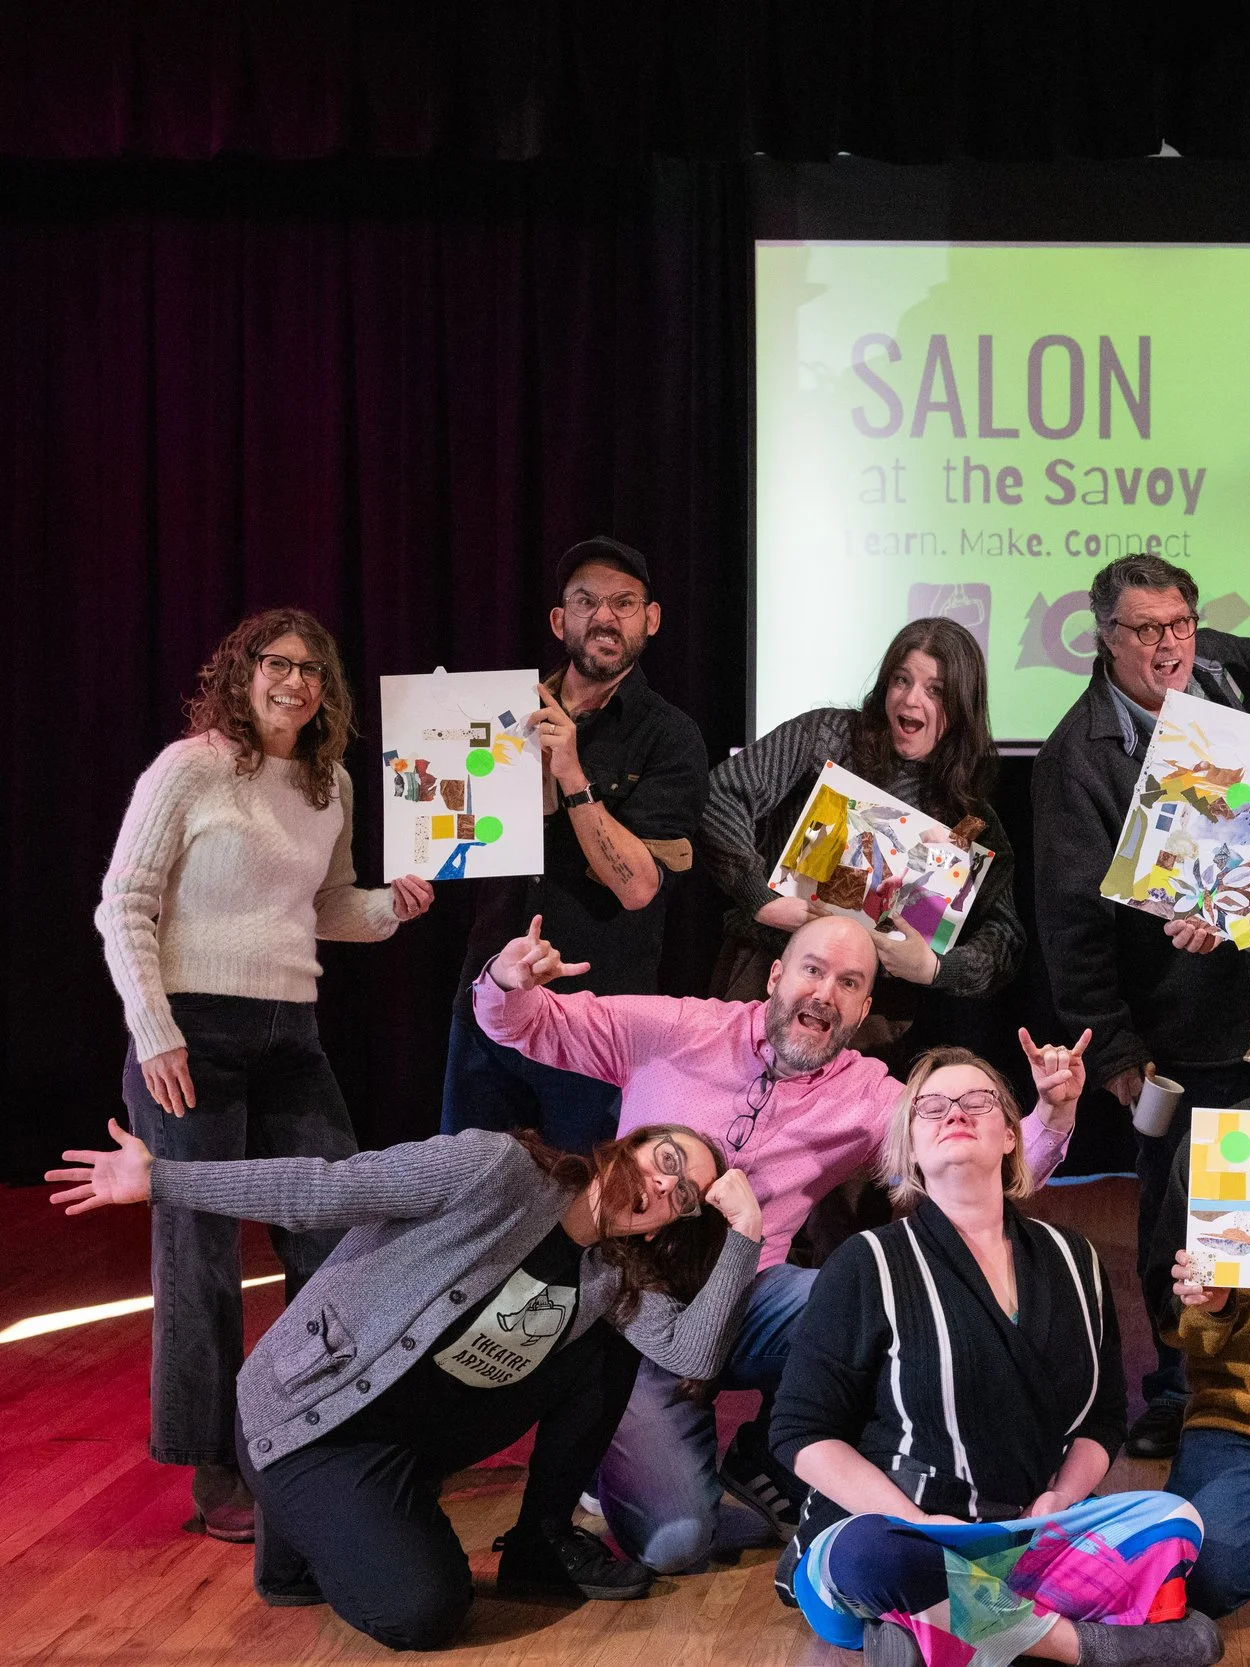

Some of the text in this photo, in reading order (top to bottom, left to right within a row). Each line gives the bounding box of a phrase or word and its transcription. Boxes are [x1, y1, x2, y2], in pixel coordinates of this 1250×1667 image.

[850, 332, 1152, 440] SALON
[858, 455, 1208, 516] at the Savoy
[959, 527, 1052, 558] Make.
[1064, 528, 1192, 559] Connect
[451, 1349, 513, 1383] ARTIBUS
[471, 1333, 531, 1372] THEATRE
